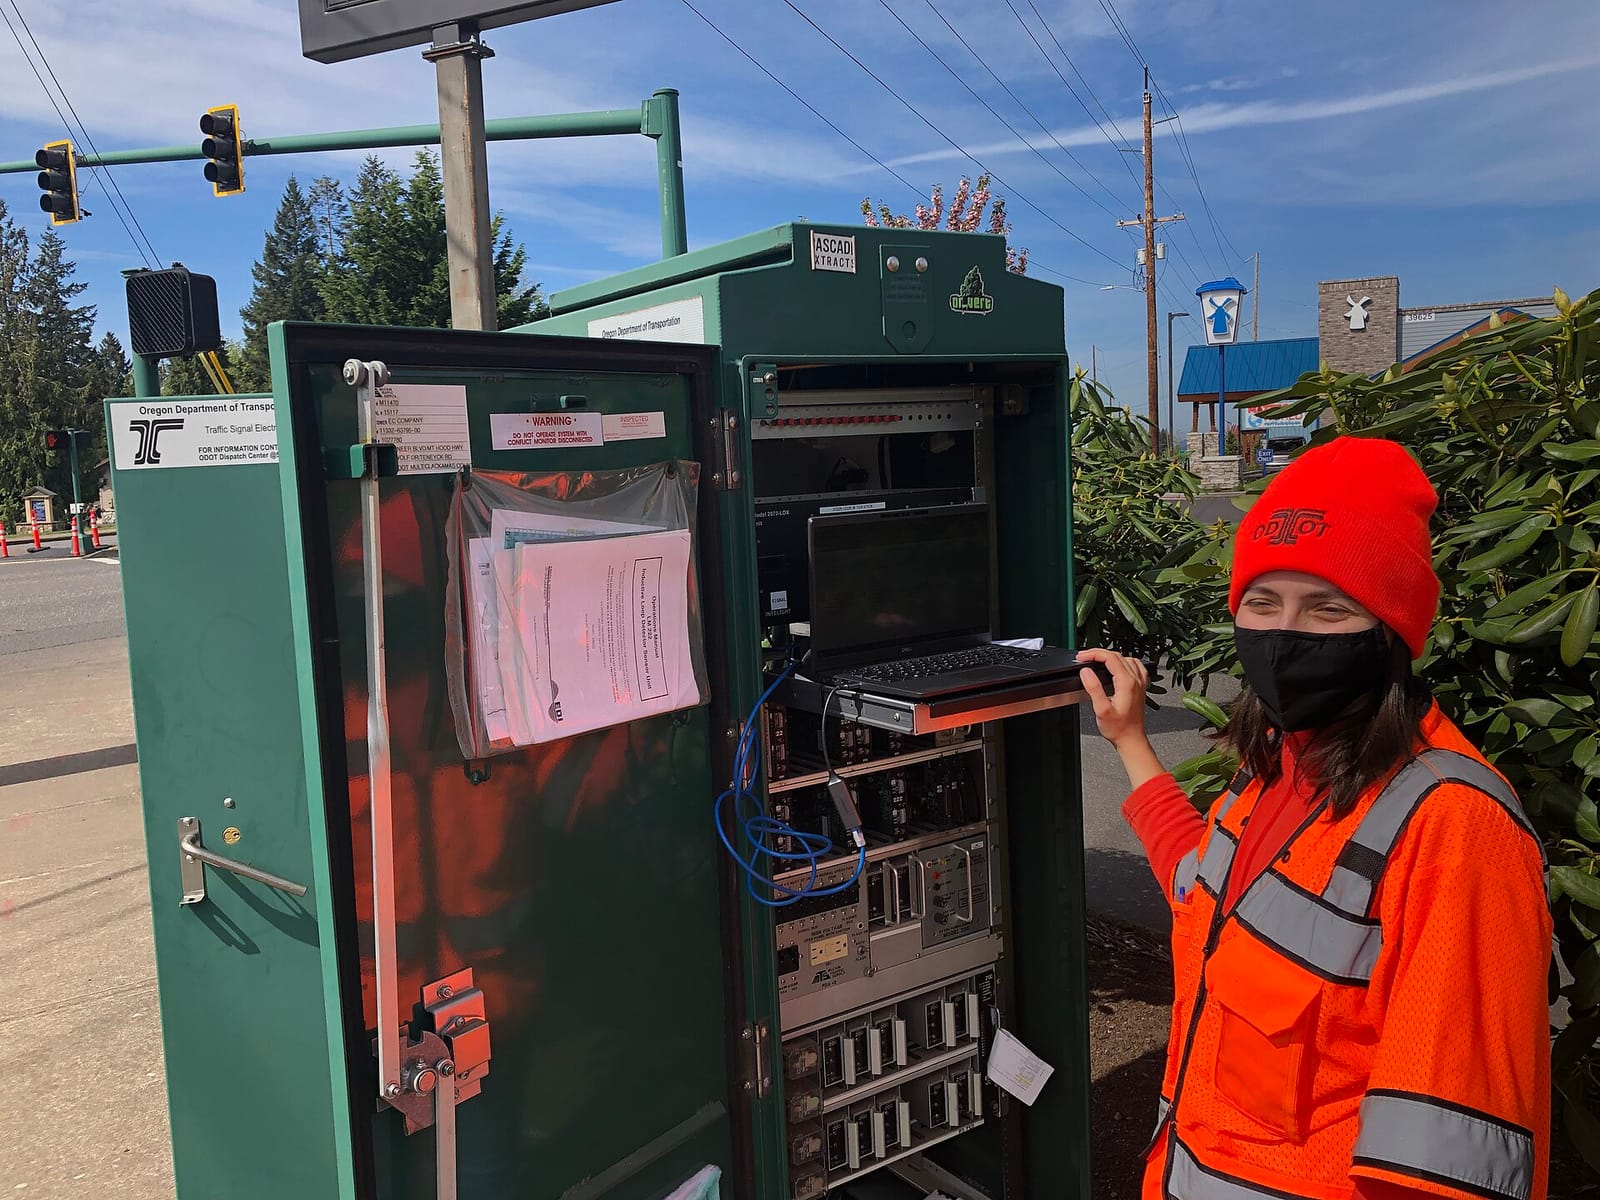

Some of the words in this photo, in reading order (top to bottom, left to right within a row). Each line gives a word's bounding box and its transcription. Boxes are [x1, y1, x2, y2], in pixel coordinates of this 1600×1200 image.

[618, 324, 642, 336] Department
[642, 322, 648, 332] of
[648, 316, 680, 330] Transportation
[139, 406, 173, 416] Oregon
[176, 404, 227, 415] Department
[230, 403, 239, 412] of
[532, 416, 572, 426] WARNING
[205, 425, 228, 434] Traffic
[230, 424, 253, 435] Signal
[220, 453, 247, 462] Dispatch
[1254, 516, 1332, 541] ODOT
[647, 616, 652, 626] LM
[555, 702, 563, 721] EDI
